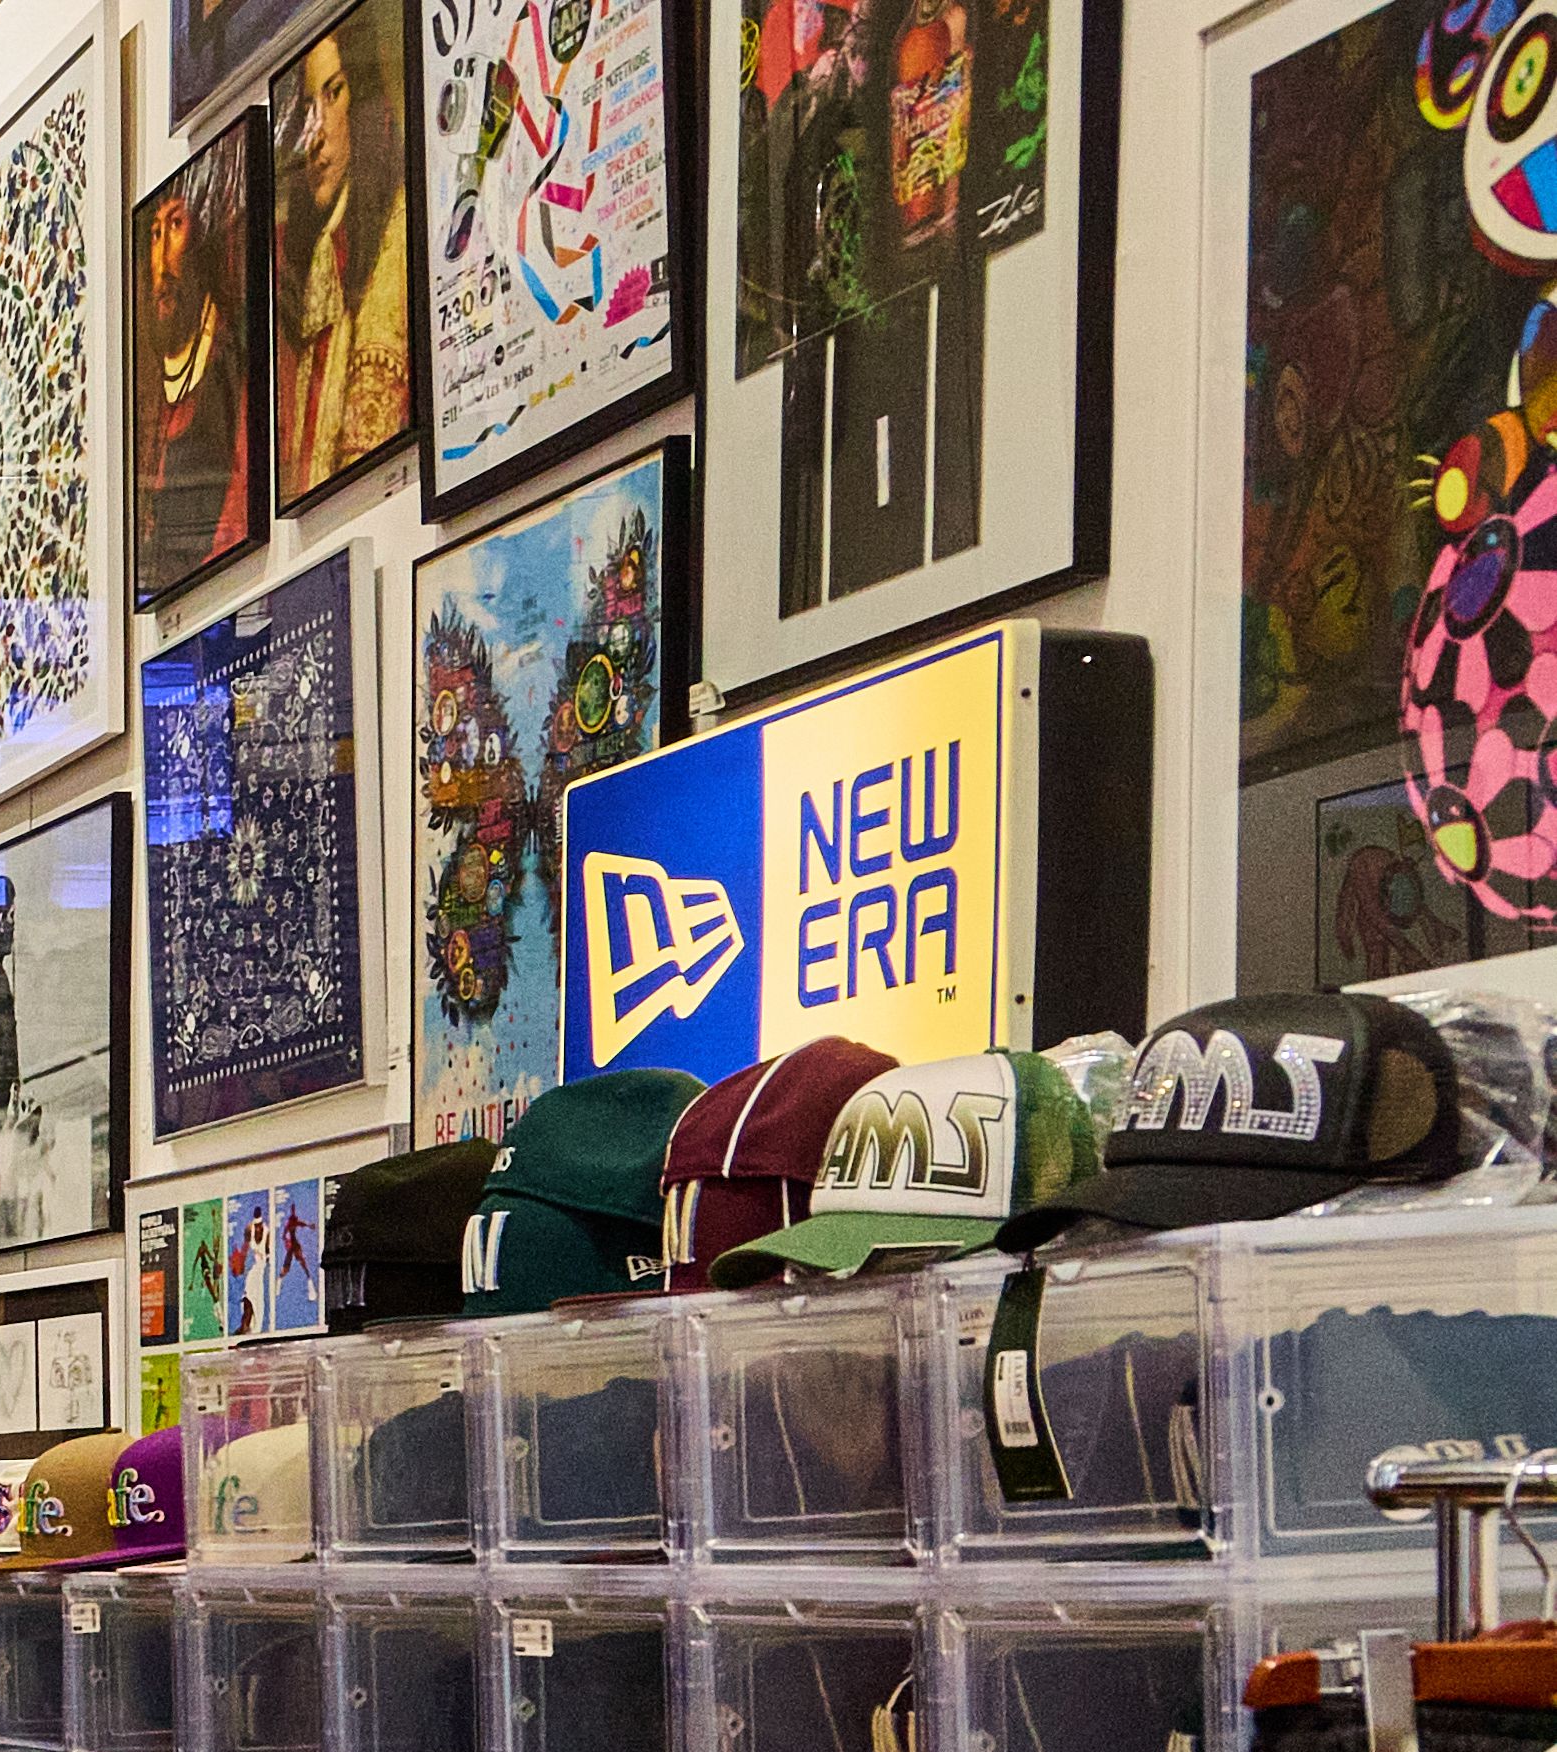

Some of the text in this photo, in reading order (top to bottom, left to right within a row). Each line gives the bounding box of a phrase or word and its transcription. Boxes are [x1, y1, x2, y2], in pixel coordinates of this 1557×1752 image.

[800, 741, 960, 896] NEW
[798, 867, 957, 1010] ERA
[937, 987, 957, 1002] TM
